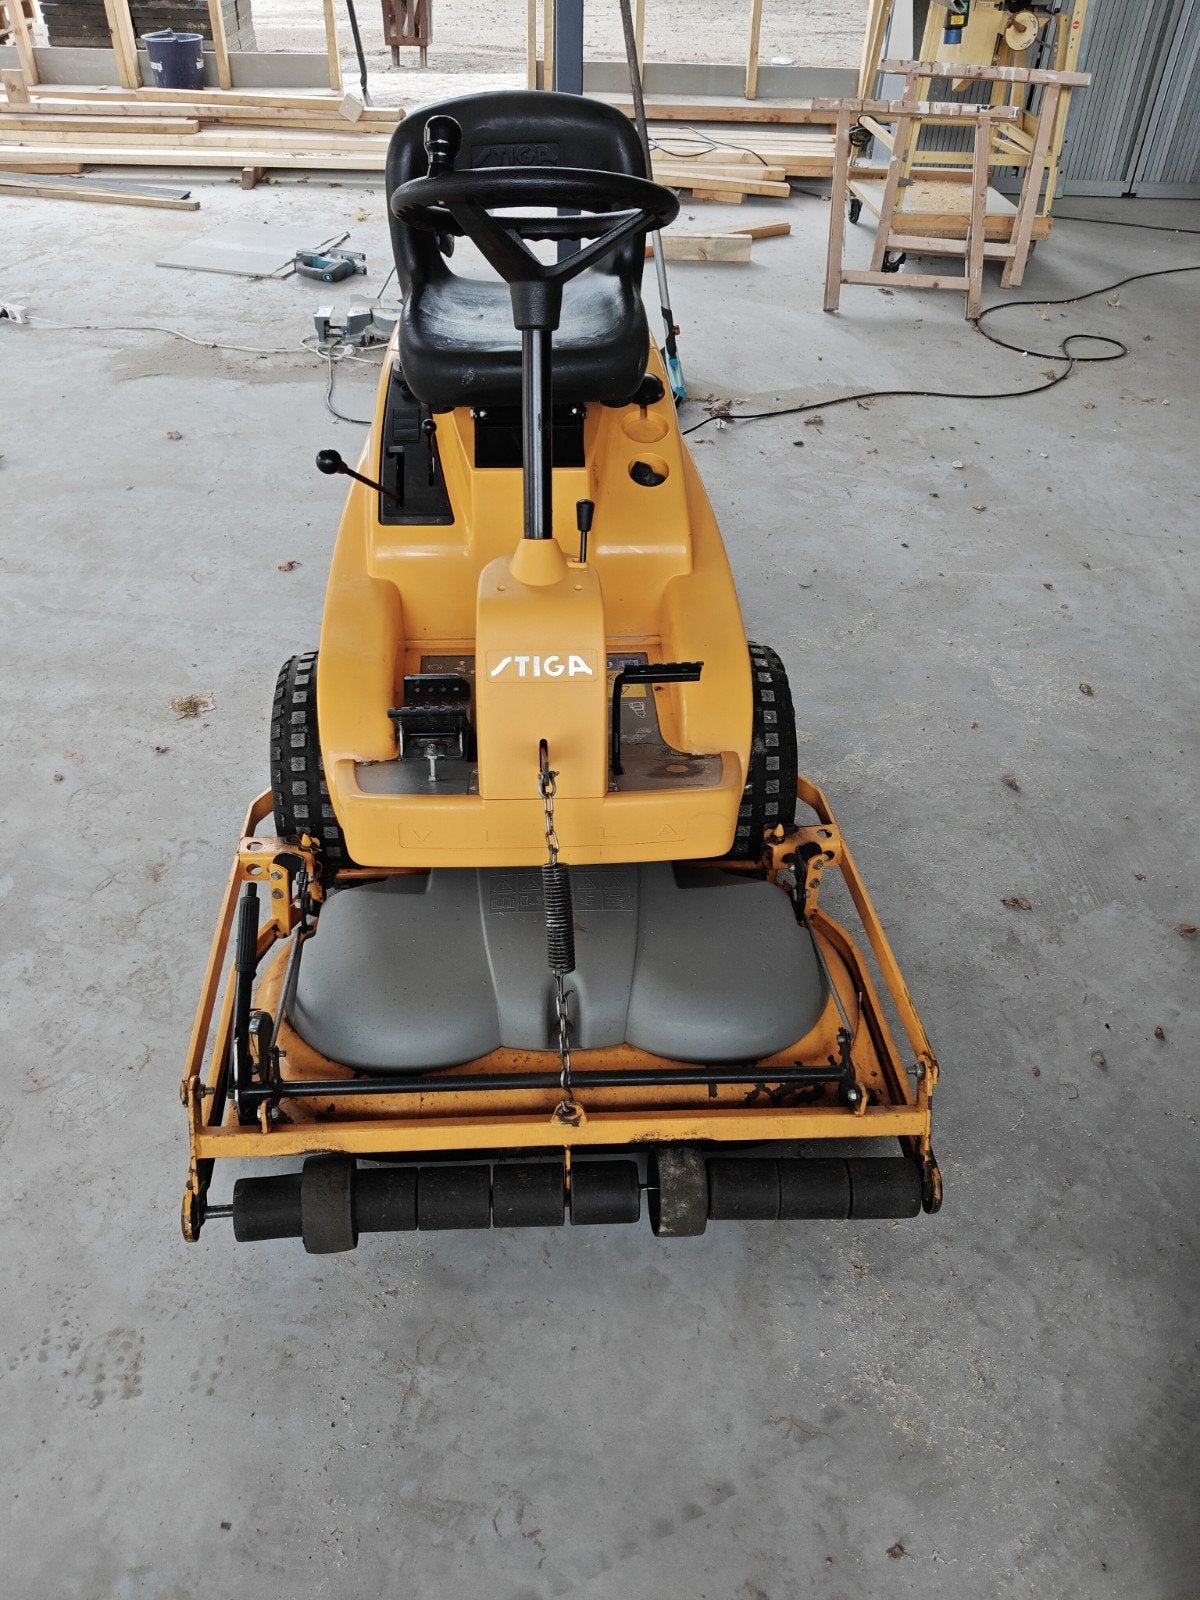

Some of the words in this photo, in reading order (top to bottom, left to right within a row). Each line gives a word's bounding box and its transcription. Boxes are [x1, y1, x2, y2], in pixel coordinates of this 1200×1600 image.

[475, 145, 559, 167] STIGA
[490, 655, 593, 677] STIGA
[409, 823, 679, 842] VILA
